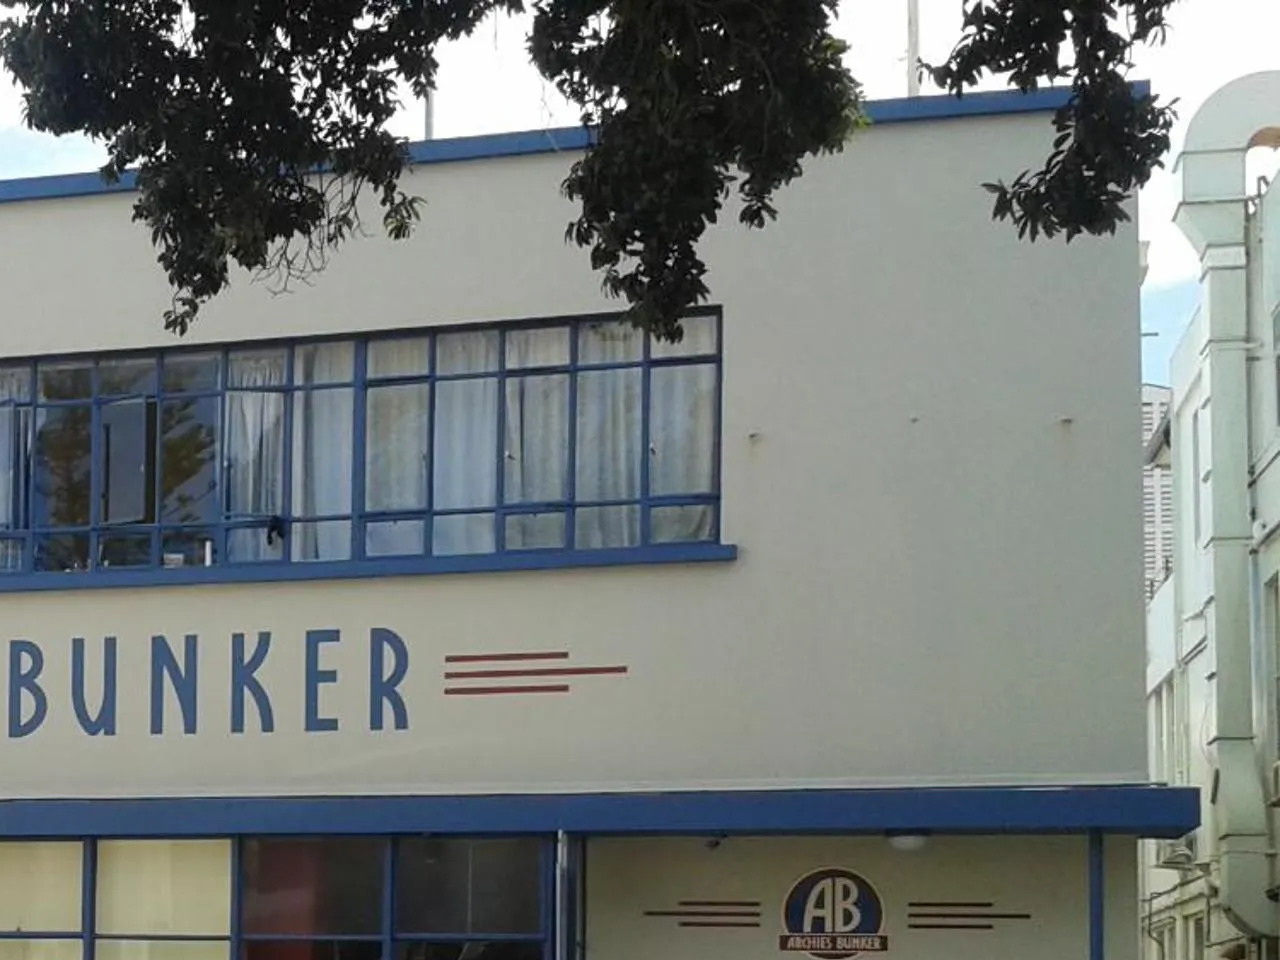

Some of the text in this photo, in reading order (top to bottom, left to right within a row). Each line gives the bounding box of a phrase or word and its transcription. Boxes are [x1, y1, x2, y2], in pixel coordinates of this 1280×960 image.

[8, 627, 410, 738] BUNKER
[802, 876, 861, 933] AB
[787, 936, 882, 950] ARCHIES BUNKER
